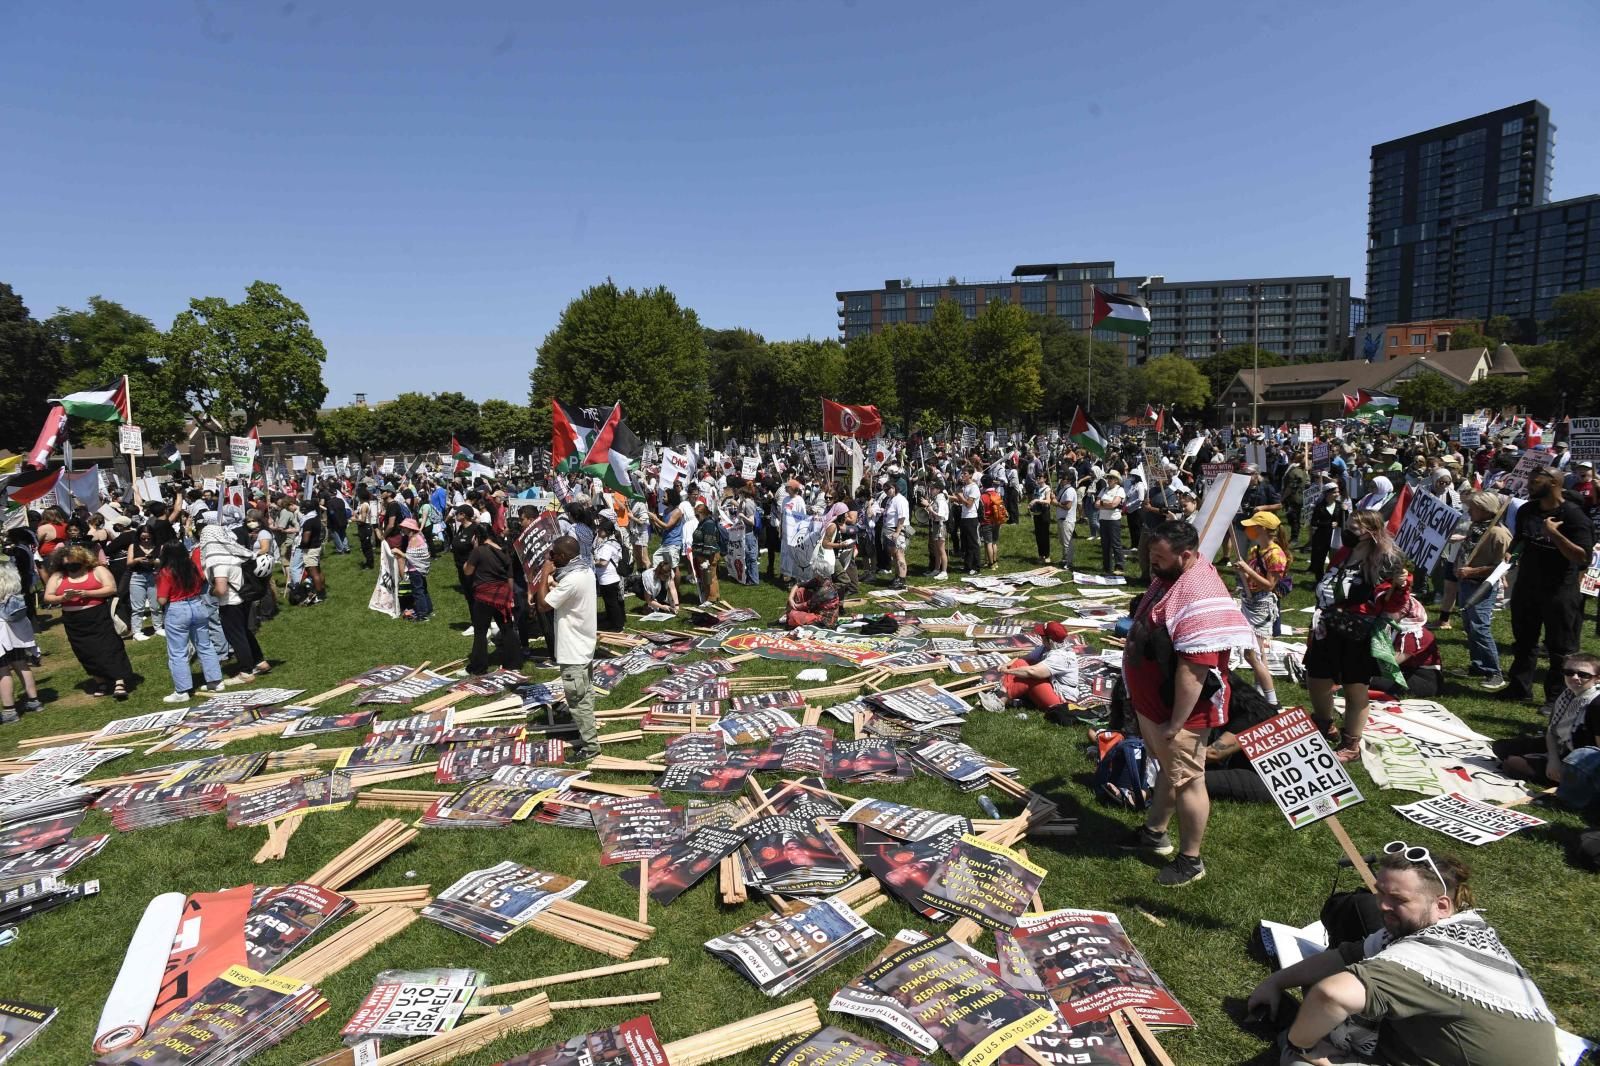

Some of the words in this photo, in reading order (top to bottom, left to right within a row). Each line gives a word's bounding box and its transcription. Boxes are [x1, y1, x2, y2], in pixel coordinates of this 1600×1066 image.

[1573, 419, 1600, 428] VICTO
[672, 455, 689, 468] DNC
[524, 527, 539, 543] END
[532, 529, 547, 543] AID
[530, 542, 541, 553] TO
[1238, 724, 1275, 746] STAND
[1276, 708, 1307, 728] WITH
[1245, 719, 1314, 758] PALESTINE!
[1259, 751, 1292, 775] END
[1271, 767, 1303, 792] AID
[1304, 753, 1334, 774] TO
[1279, 769, 1347, 808] ISRAEL!
[1428, 799, 1514, 831] PALESTINIAN
[1440, 796, 1525, 827] RESISTANCE
[1400, 808, 1482, 842] VICTORY
[616, 833, 672, 841] ISRAEL
[947, 860, 962, 870] ON
[960, 855, 995, 872] HANDS!
[965, 868, 999, 883] BLOOD
[997, 868, 1024, 887] THEIR
[948, 871, 1017, 903] REPUBLICANS
[1001, 878, 1028, 899] HAVE
[478, 890, 499, 904] THE
[489, 892, 512, 908] OF
[923, 893, 961, 911] PALESTINE
[951, 883, 1014, 912] DEMOCRATS
[956, 894, 986, 910] BOTH
[963, 908, 982, 920] WITH
[802, 923, 828, 944] OF
[985, 918, 1011, 932] STAND
[1027, 923, 1049, 934] FREE
[1048, 915, 1094, 929] PALESTINE
[1048, 926, 1090, 942] END
[1076, 936, 1111, 946] AID
[869, 961, 894, 980] STAND
[894, 950, 912, 964] WITH
[912, 936, 948, 955] PALESTINE
[1070, 947, 1098, 959] TO
[749, 954, 769, 978] STAND
[908, 955, 937, 973] BOTH
[1055, 957, 1132, 980] ISRAEL
[899, 961, 958, 994] DEMOCRATS
[957, 958, 968, 969] &
[914, 968, 980, 1004] REPUBLICANS
[832, 1000, 875, 1014] PALESTINE
[919, 1000, 950, 1021] HAVE
[950, 984, 983, 1004] BLOOD
[983, 976, 998, 988] ON
[1070, 996, 1095, 1008] MONEY
[1094, 992, 1107, 1001] FOR
[220, 1002, 249, 1017] THEIR
[345, 1009, 371, 1033] STAND
[368, 986, 387, 1007] WITH
[357, 985, 399, 1033] PALESTINE!
[400, 1010, 421, 1031] AID
[413, 987, 435, 1007] TO
[414, 988, 454, 1032] ISRAEL!
[876, 1008, 898, 1023] WITH
[940, 1008, 971, 1029] THEIR
[971, 989, 1007, 1013] HANDS!
[1099, 1004, 1112, 1014] NOT
[377, 1011, 403, 1030] END
[902, 1022, 932, 1044] STAND
[967, 1052, 985, 1066] END
[999, 1033, 1014, 1047] AID
[1012, 1025, 1024, 1037] TO
[1022, 1013, 1049, 1031] ISRAEL
[769, 1044, 788, 1065] WITH
[787, 1045, 817, 1066] BOTH
[871, 1050, 888, 1064] ON
